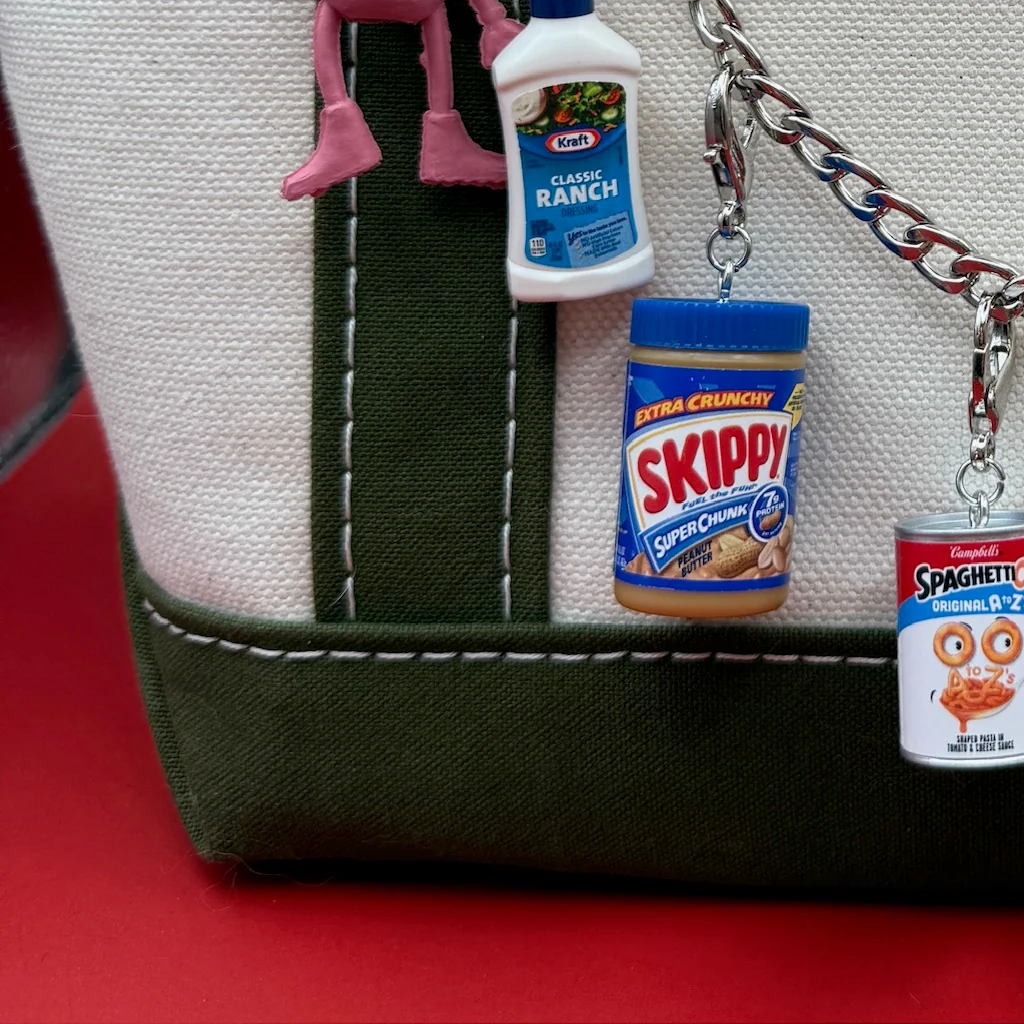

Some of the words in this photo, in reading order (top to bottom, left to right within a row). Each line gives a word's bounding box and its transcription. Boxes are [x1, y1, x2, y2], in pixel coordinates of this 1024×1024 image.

[557, 134, 590, 149] Kraft
[551, 169, 603, 186] CLASSIC
[536, 179, 619, 208] RANCH
[561, 204, 599, 217] DRESSING
[532, 239, 545, 247] 110
[635, 398, 684, 428] EXTRA
[686, 392, 774, 412] CRUNCHY
[637, 423, 788, 515] SKIPPY
[756, 501, 785, 518] PROTEIN
[677, 540, 713, 568] PEANUT
[950, 544, 999, 560] Campbell's
[681, 552, 713, 578] BUTTER
[932, 598, 989, 612] ORIGINAL
[988, 594, 1003, 612] A
[947, 743, 967, 752] TOMATO
[975, 742, 996, 752] CHEESE
[998, 739, 1014, 750] SAUCE
[957, 735, 978, 743] SHAPED
[979, 734, 996, 742] PASTA
